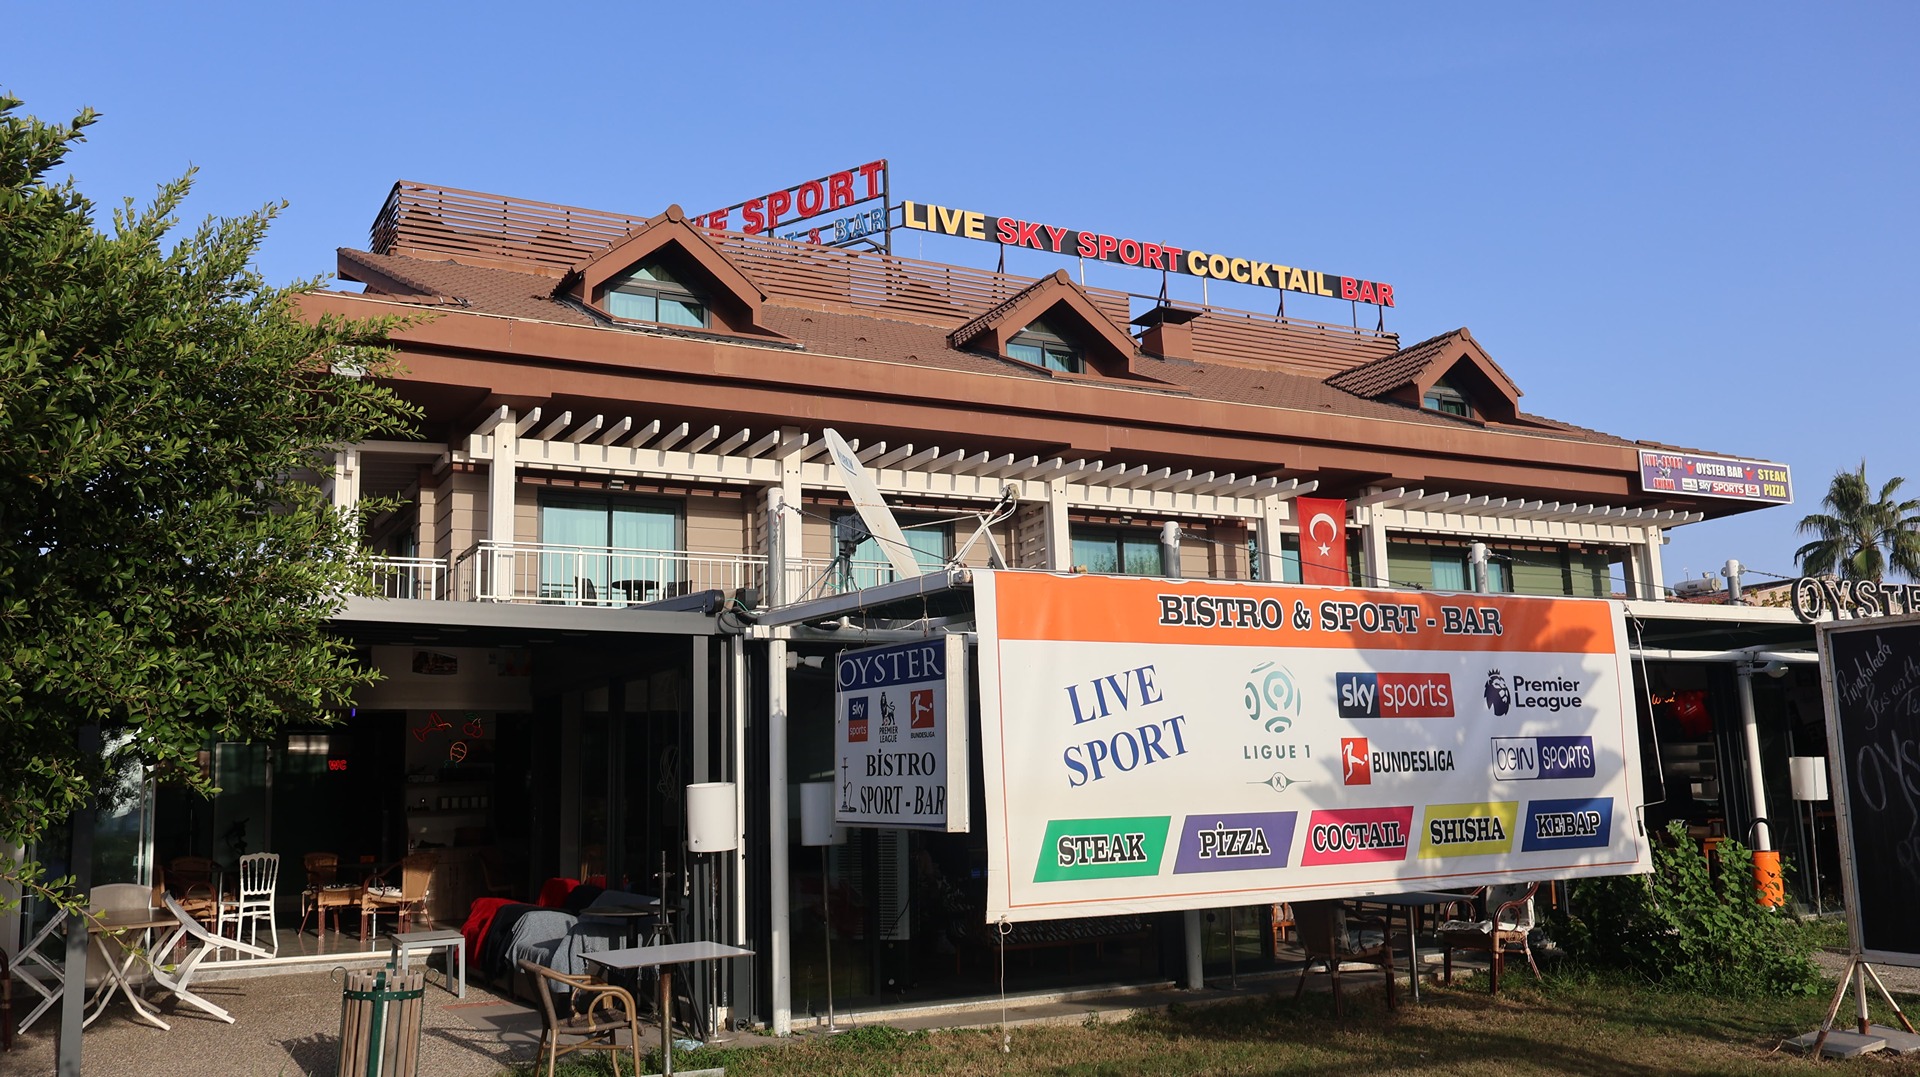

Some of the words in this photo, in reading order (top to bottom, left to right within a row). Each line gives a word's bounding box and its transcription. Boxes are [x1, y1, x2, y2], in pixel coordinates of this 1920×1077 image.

[741, 159, 885, 236] SPORT
[832, 206, 887, 243] BAR
[904, 200, 986, 241] LIVE
[997, 217, 1068, 252] SKY
[1077, 231, 1182, 271] SPORT
[1187, 250, 1333, 296] COCKTAIL
[1340, 276, 1395, 307] BAR
[1696, 462, 1726, 477] OYSTER
[1727, 467, 1744, 479] BAR
[1757, 469, 1787, 483] STEAK
[1712, 482, 1745, 494] SPORTS
[1763, 483, 1786, 499] PIZZA
[1158, 594, 1283, 629] BISTRO
[1293, 601, 1312, 631] &
[1319, 602, 1418, 633] SPORT
[1442, 606, 1503, 636] BAR
[839, 647, 943, 687] OYSTER
[1064, 665, 1163, 725] LIVE
[1341, 677, 1375, 714] sky
[1383, 680, 1448, 713] sports
[1513, 676, 1580, 692] Premier
[852, 701, 864, 717] sky
[1514, 692, 1582, 712] League
[850, 726, 866, 737] sports
[879, 726, 898, 735] PREMIER
[880, 735, 897, 743] LEAGUE
[910, 731, 935, 739] BUNDESLIGA
[866, 748, 936, 777] BİSTRO
[1063, 715, 1188, 788] SPORT
[1244, 745, 1296, 759] LIGUE
[1305, 745, 1310, 758] 1
[1372, 750, 1455, 773] BUNDESLIGA
[1542, 746, 1591, 770] SPORTS
[860, 785, 903, 815] SPORT
[913, 785, 946, 815] BAR
[1312, 822, 1406, 852] COCTAIL
[1430, 816, 1506, 845] SHISHA
[1535, 811, 1600, 838] KEBAP
[1057, 833, 1148, 866] STEAK
[1199, 821, 1271, 858] PİZZA
